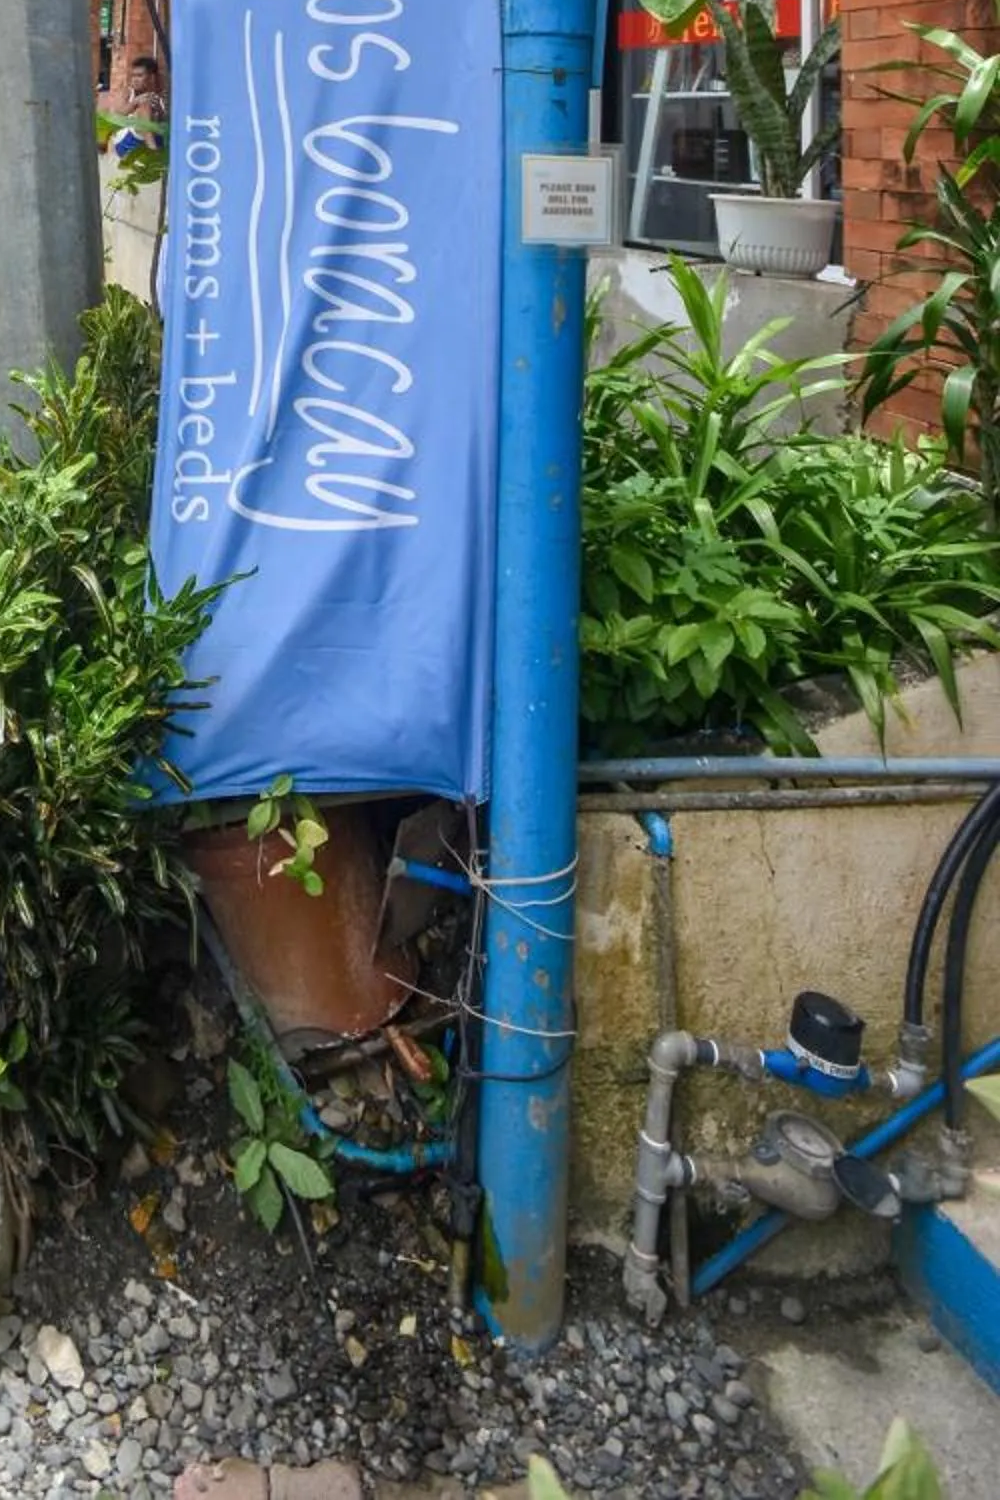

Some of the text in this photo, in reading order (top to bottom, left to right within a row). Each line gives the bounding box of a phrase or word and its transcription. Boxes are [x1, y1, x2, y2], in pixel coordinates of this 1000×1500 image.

[172, 115, 236, 524] rooms + beds
[227, 115, 459, 531] boracay
